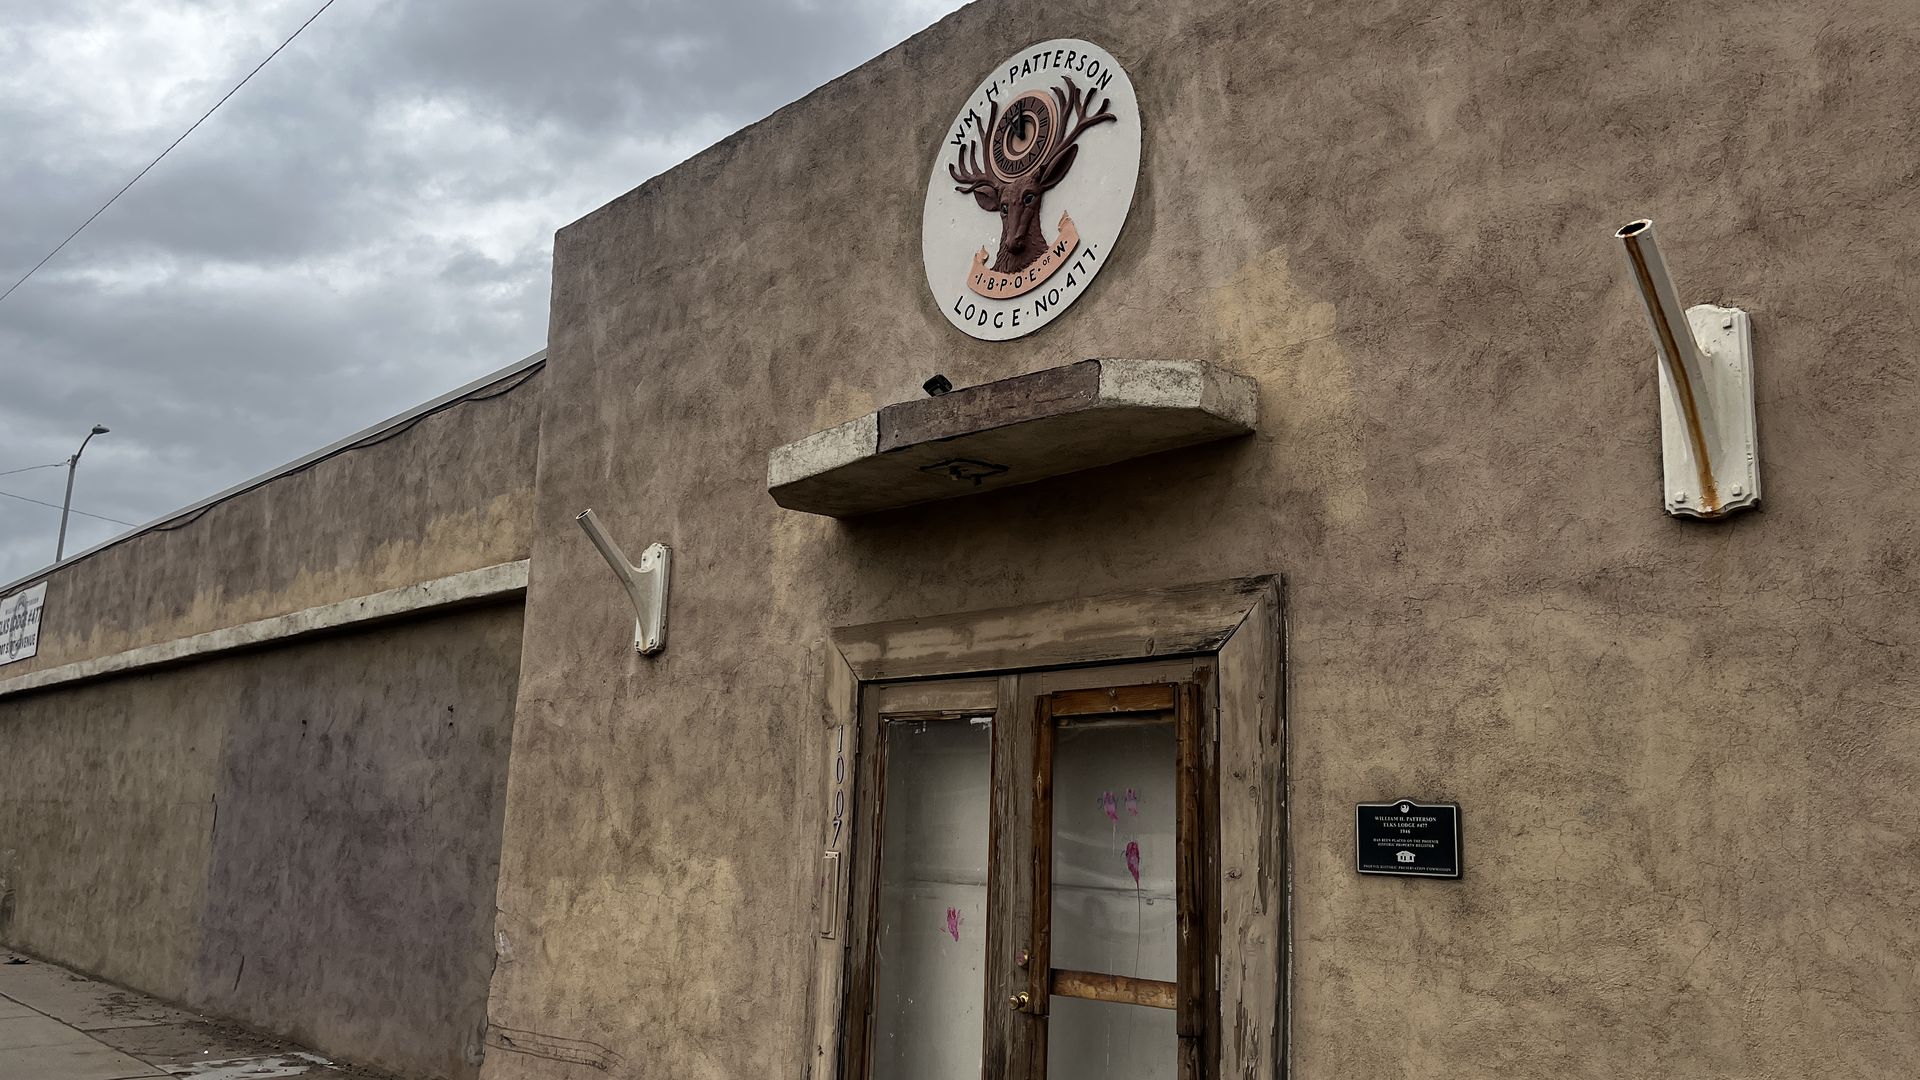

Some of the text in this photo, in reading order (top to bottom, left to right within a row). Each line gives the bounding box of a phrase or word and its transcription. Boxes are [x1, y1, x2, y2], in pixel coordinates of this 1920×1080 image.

[1009, 50, 1112, 91] PATTERSON
[953, 296, 1021, 329] LODGE
[832, 725, 845, 848] 1007
